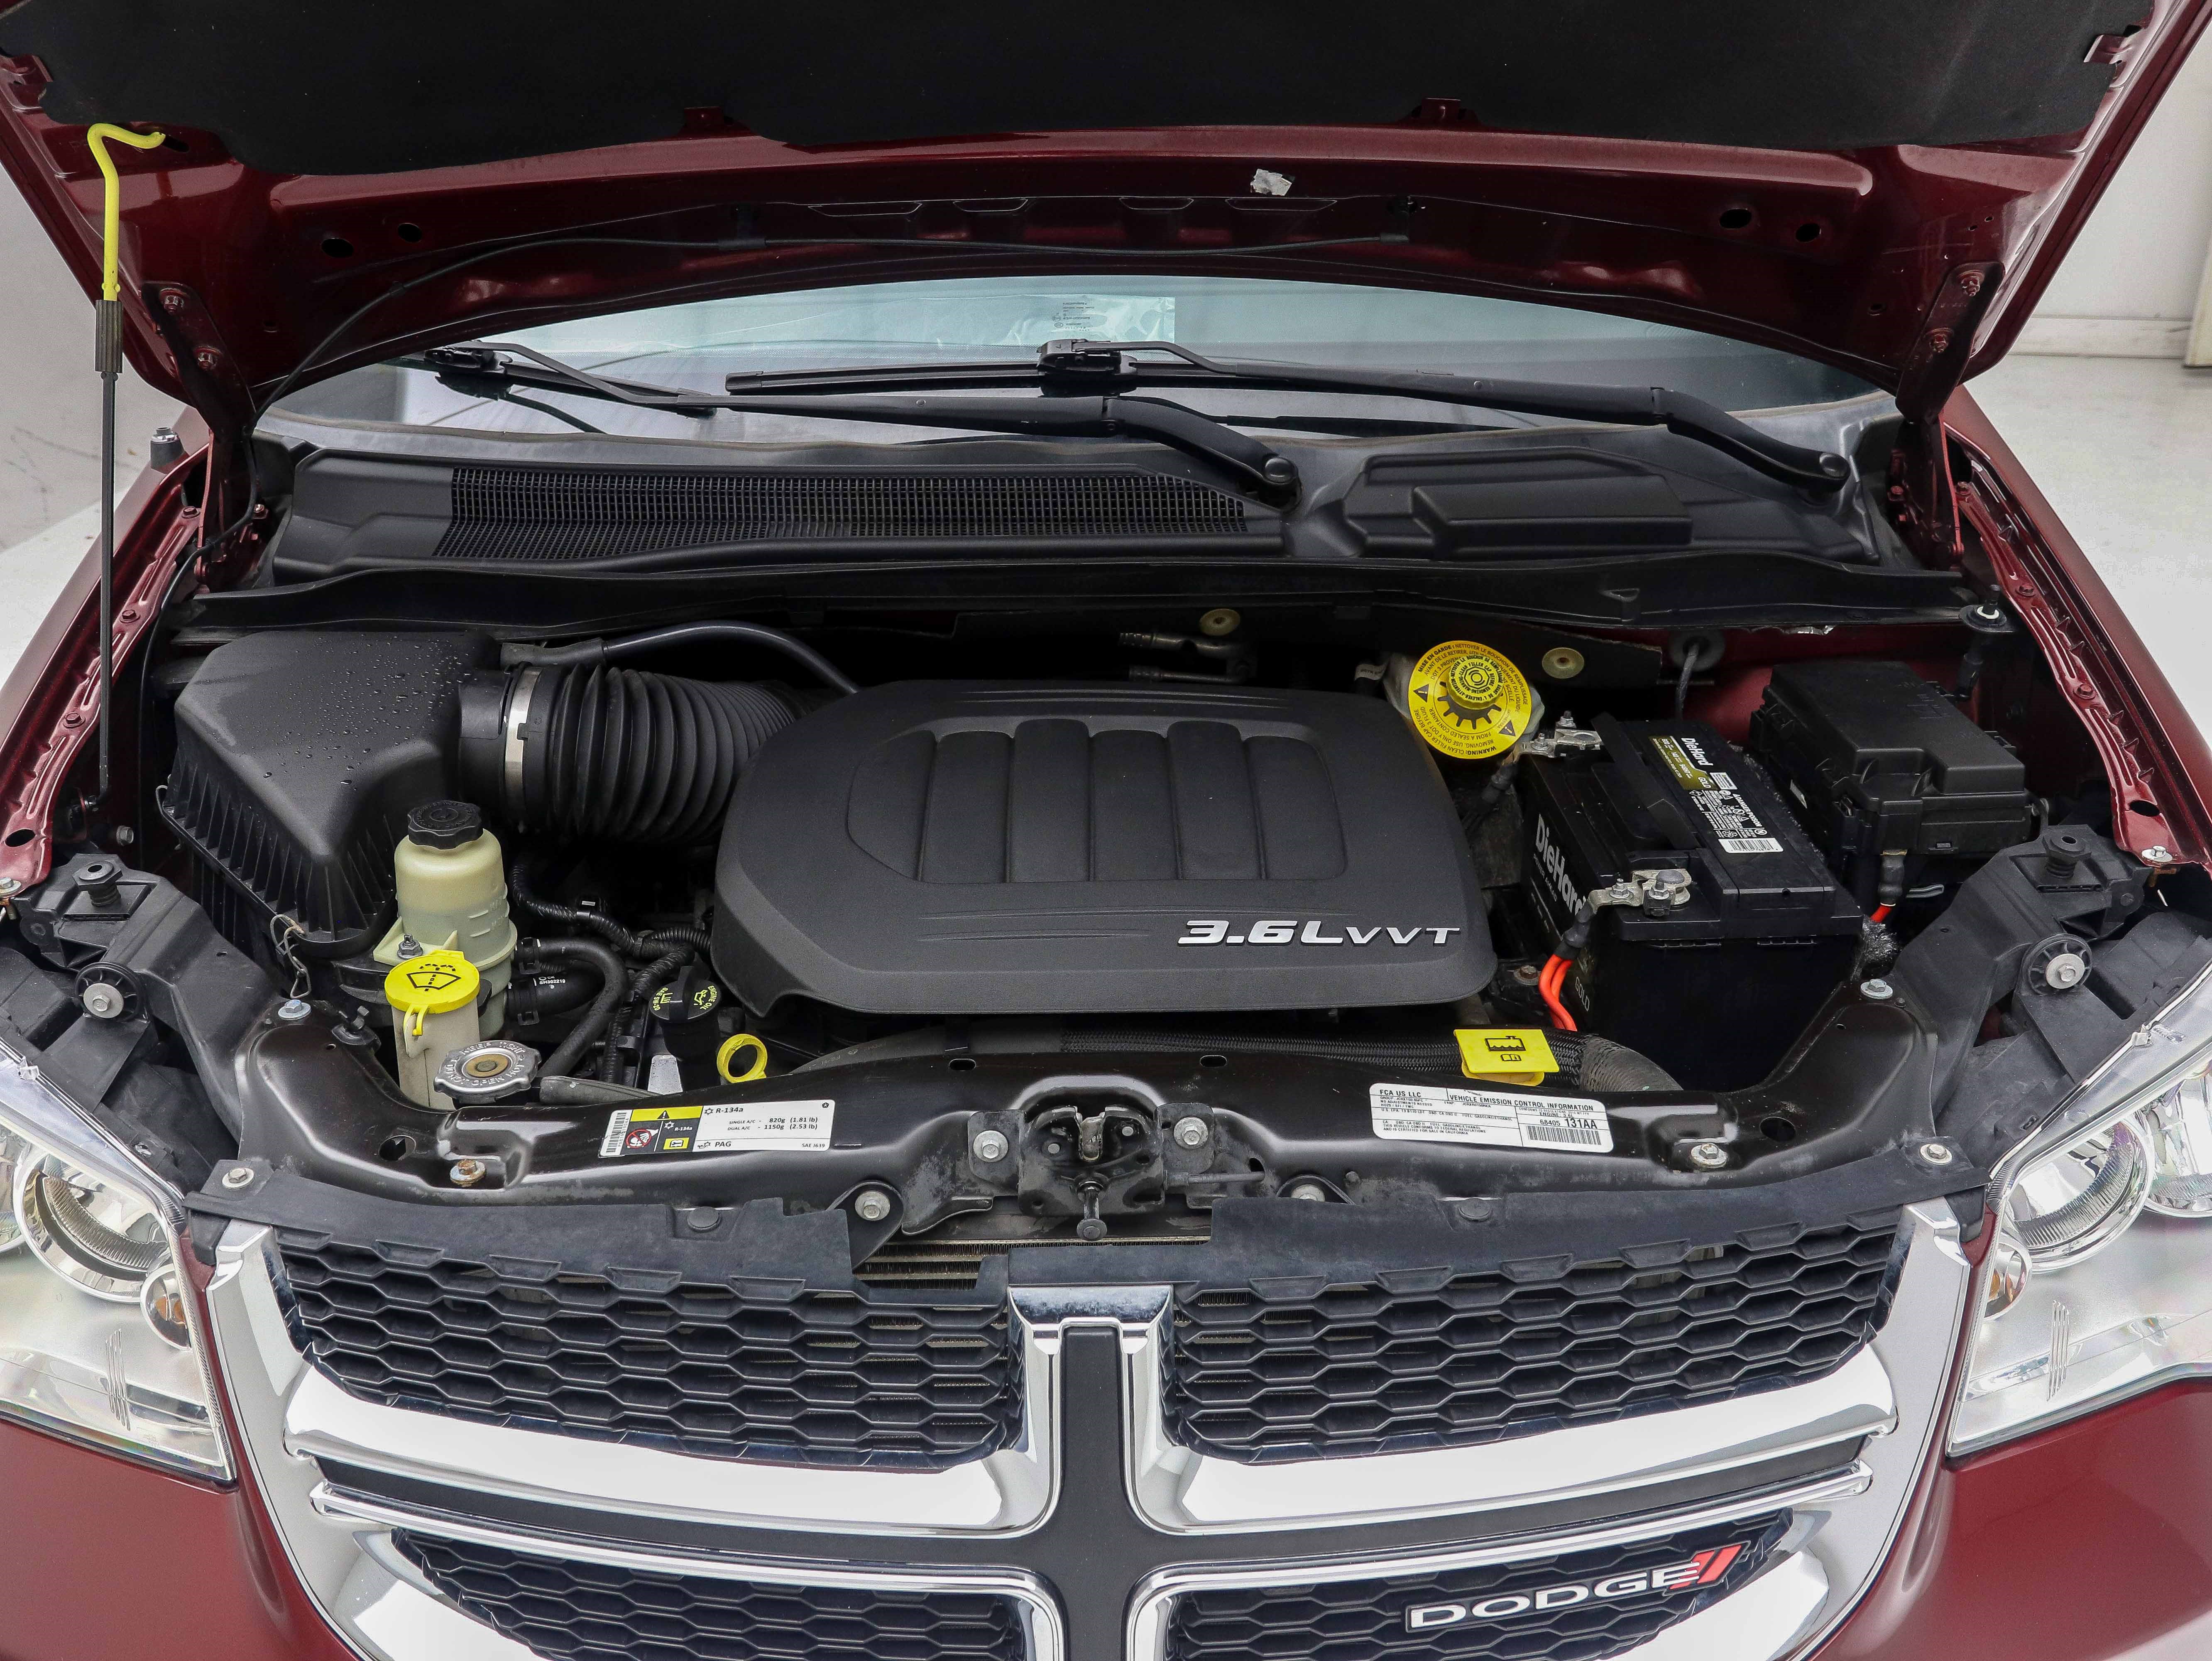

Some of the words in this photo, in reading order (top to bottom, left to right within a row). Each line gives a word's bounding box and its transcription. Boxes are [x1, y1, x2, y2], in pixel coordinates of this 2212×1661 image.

[1418, 659, 1429, 672] MISE
[1434, 644, 1452, 655] GARDE
[1487, 650, 1510, 669] BOUCHON
[1514, 674, 1528, 705] REMPLISSAGE
[1424, 661, 1436, 676] AVANT
[1414, 708, 1425, 728] BEFORE
[1420, 707, 1429, 722] FLUID
[1424, 728, 1432, 737] CAP
[1430, 725, 1439, 735] DOT
[1450, 732, 1469, 740] SEALED
[1431, 736, 1447, 749] FILLER
[1439, 733, 1452, 743] ONLY
[1447, 745, 1464, 755] CLEAN
[1466, 746, 1497, 755] WARNING:
[1681, 737, 1714, 766] DieHard
[1698, 777, 1711, 788] GOLD
[656, 987, 668, 996] SAE
[707, 985, 717, 1002] ENGINE
[1575, 976, 1590, 1012] GOLD
[652, 997, 661, 1011] 5W-20
[460, 1042, 492, 1055] KEEP
[471, 1076, 505, 1086] OPEN
[1547, 1103, 1594, 1111] INFORMATION
[1564, 1118, 1598, 1129] 131AA
[1410, 1561, 1701, 1629] DODGE
